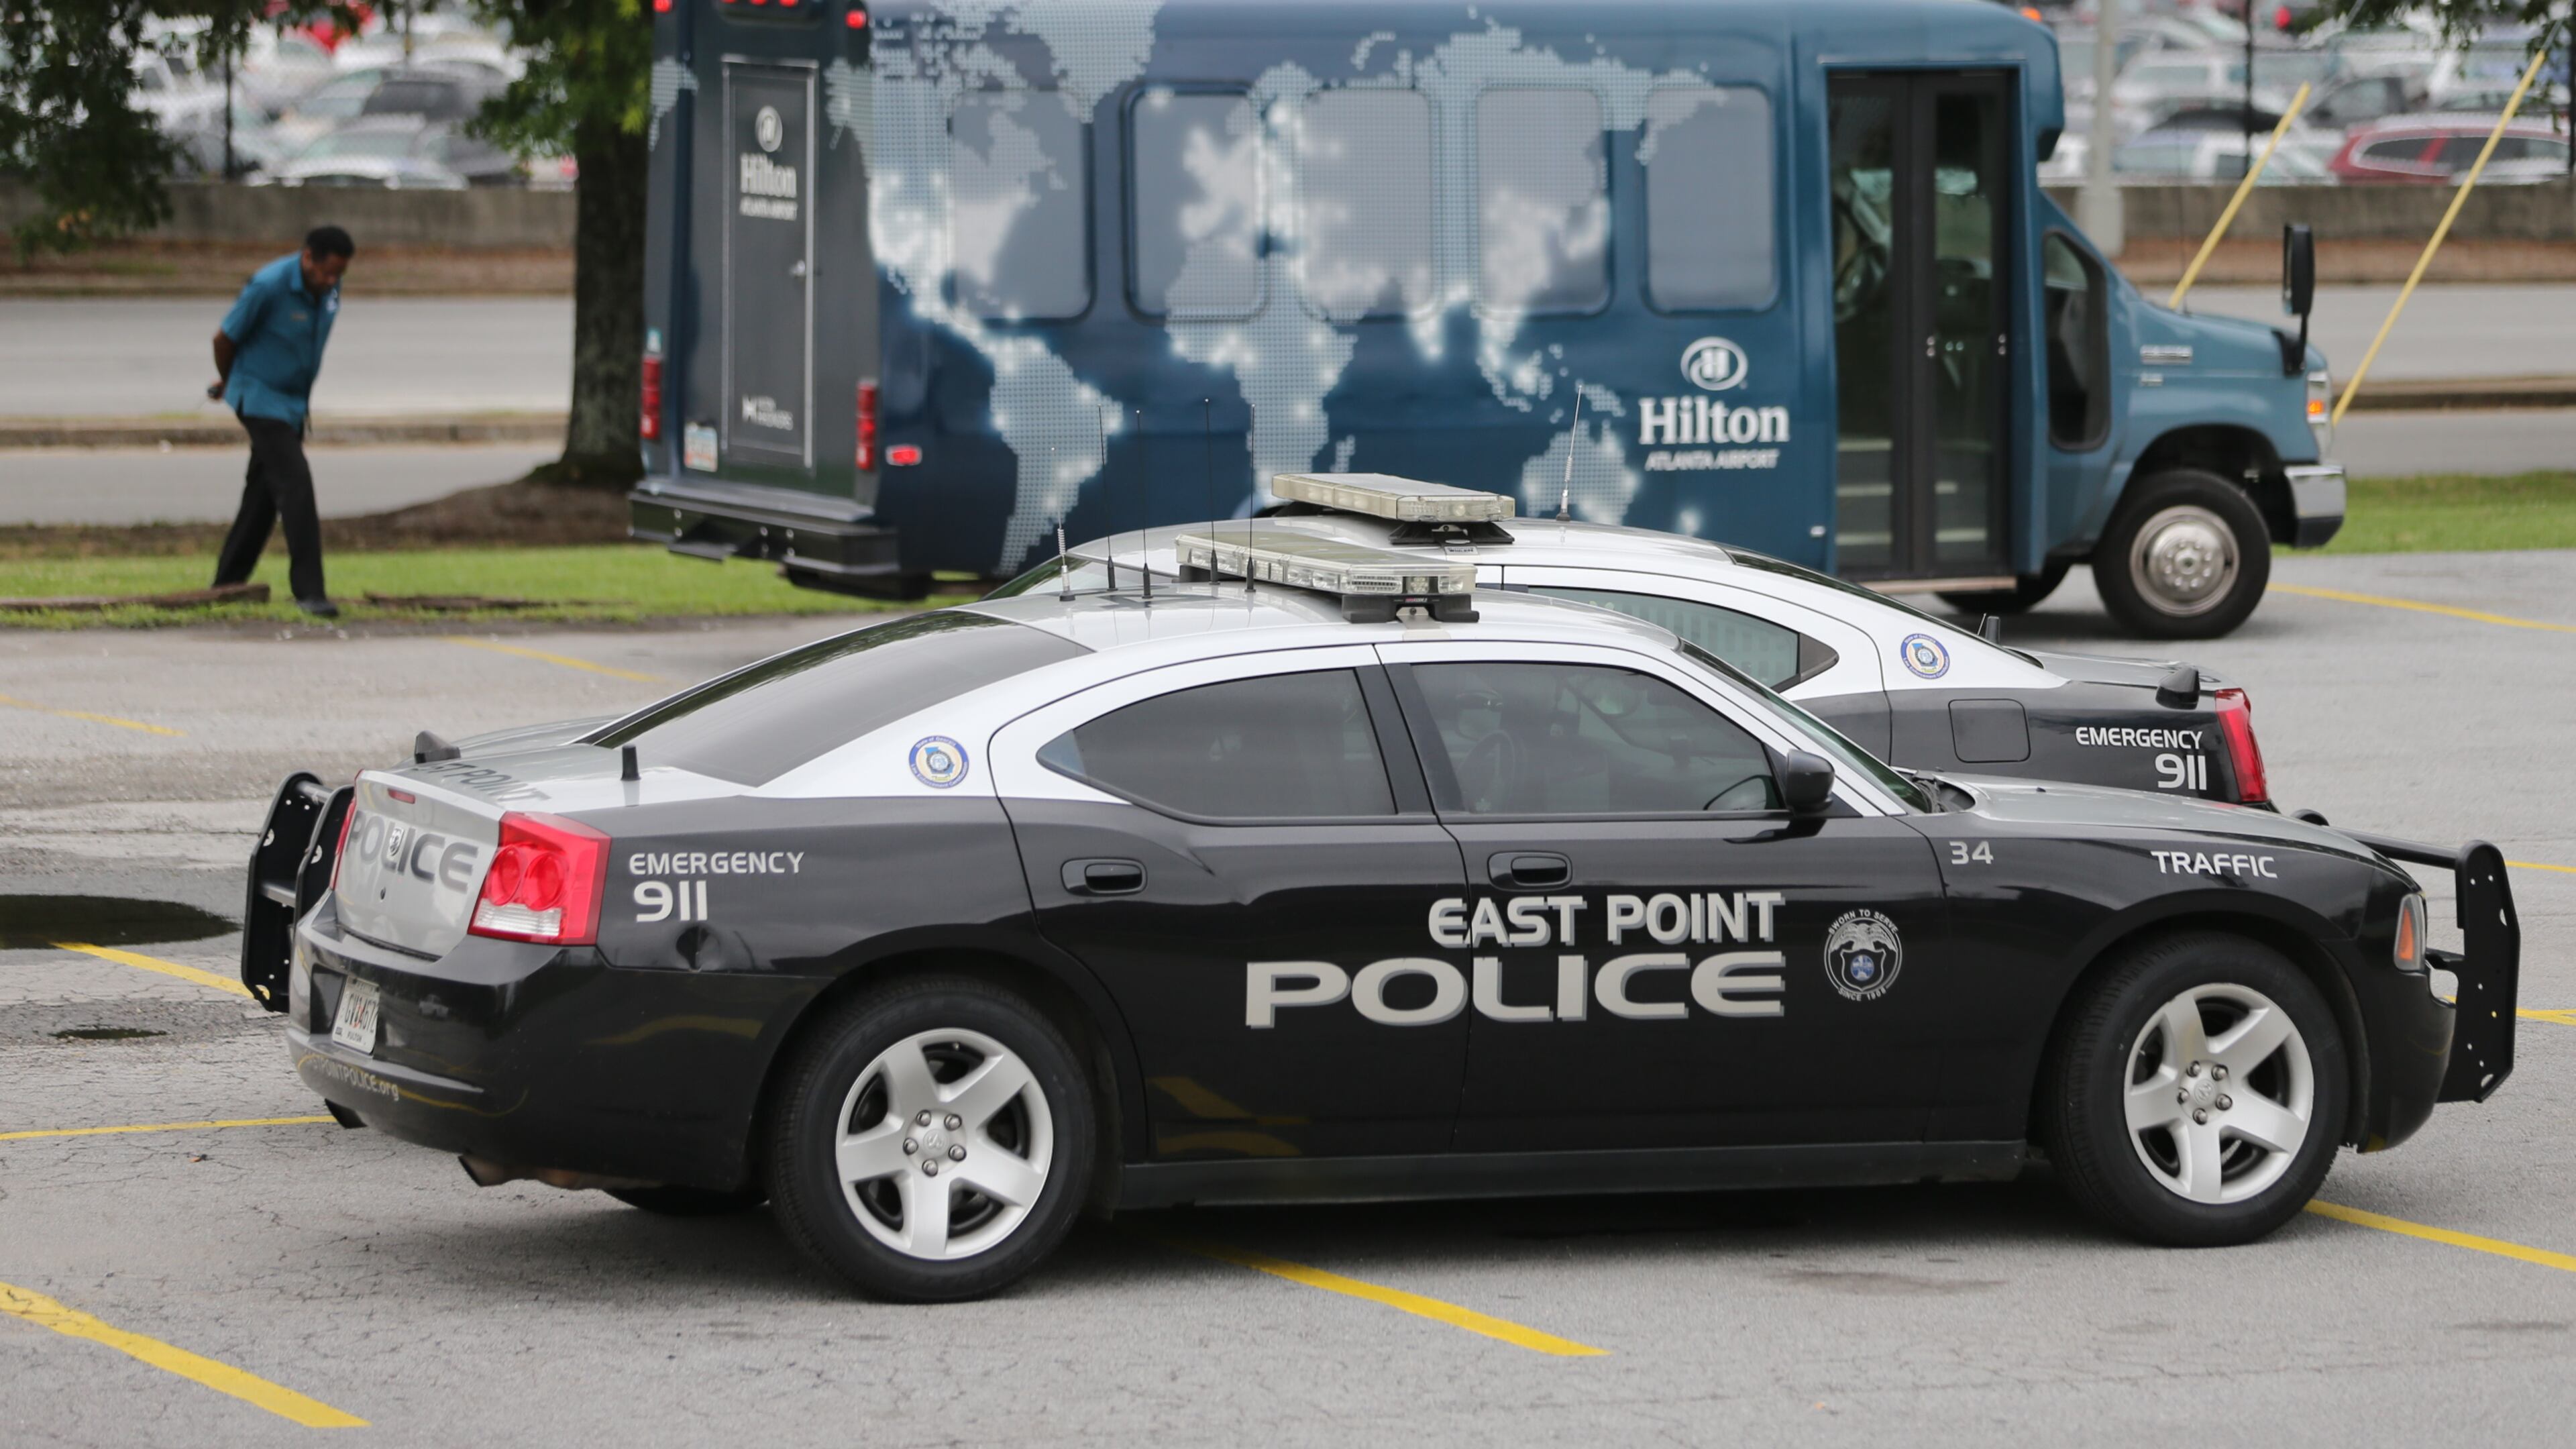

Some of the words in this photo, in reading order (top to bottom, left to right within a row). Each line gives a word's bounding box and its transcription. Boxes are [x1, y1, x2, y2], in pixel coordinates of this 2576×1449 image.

[741, 153, 797, 198] Hilton
[1638, 395, 1791, 445] Hilton
[1644, 449, 1715, 472] ATLANTA
[1713, 448, 1780, 470] AIRPORT
[2076, 727, 2202, 749] EMERGENCY
[443, 769, 551, 802] POINT
[2155, 753, 2207, 790] 911
[345, 810, 479, 895] POLICE
[629, 851, 805, 875] EMERGENCY
[1949, 840, 1994, 865] 34
[2150, 851, 2278, 879] TRAFFIC
[633, 880, 708, 922] 911
[1428, 896, 1589, 948] EAST
[1607, 892, 1787, 944] POINT
[1828, 910, 1856, 934] SWORN
[1859, 909, 1871, 917] TO
[1874, 911, 1898, 934] SERVE
[1245, 951, 1786, 1028] POLICE
[1839, 987, 1862, 1002] SINCE
